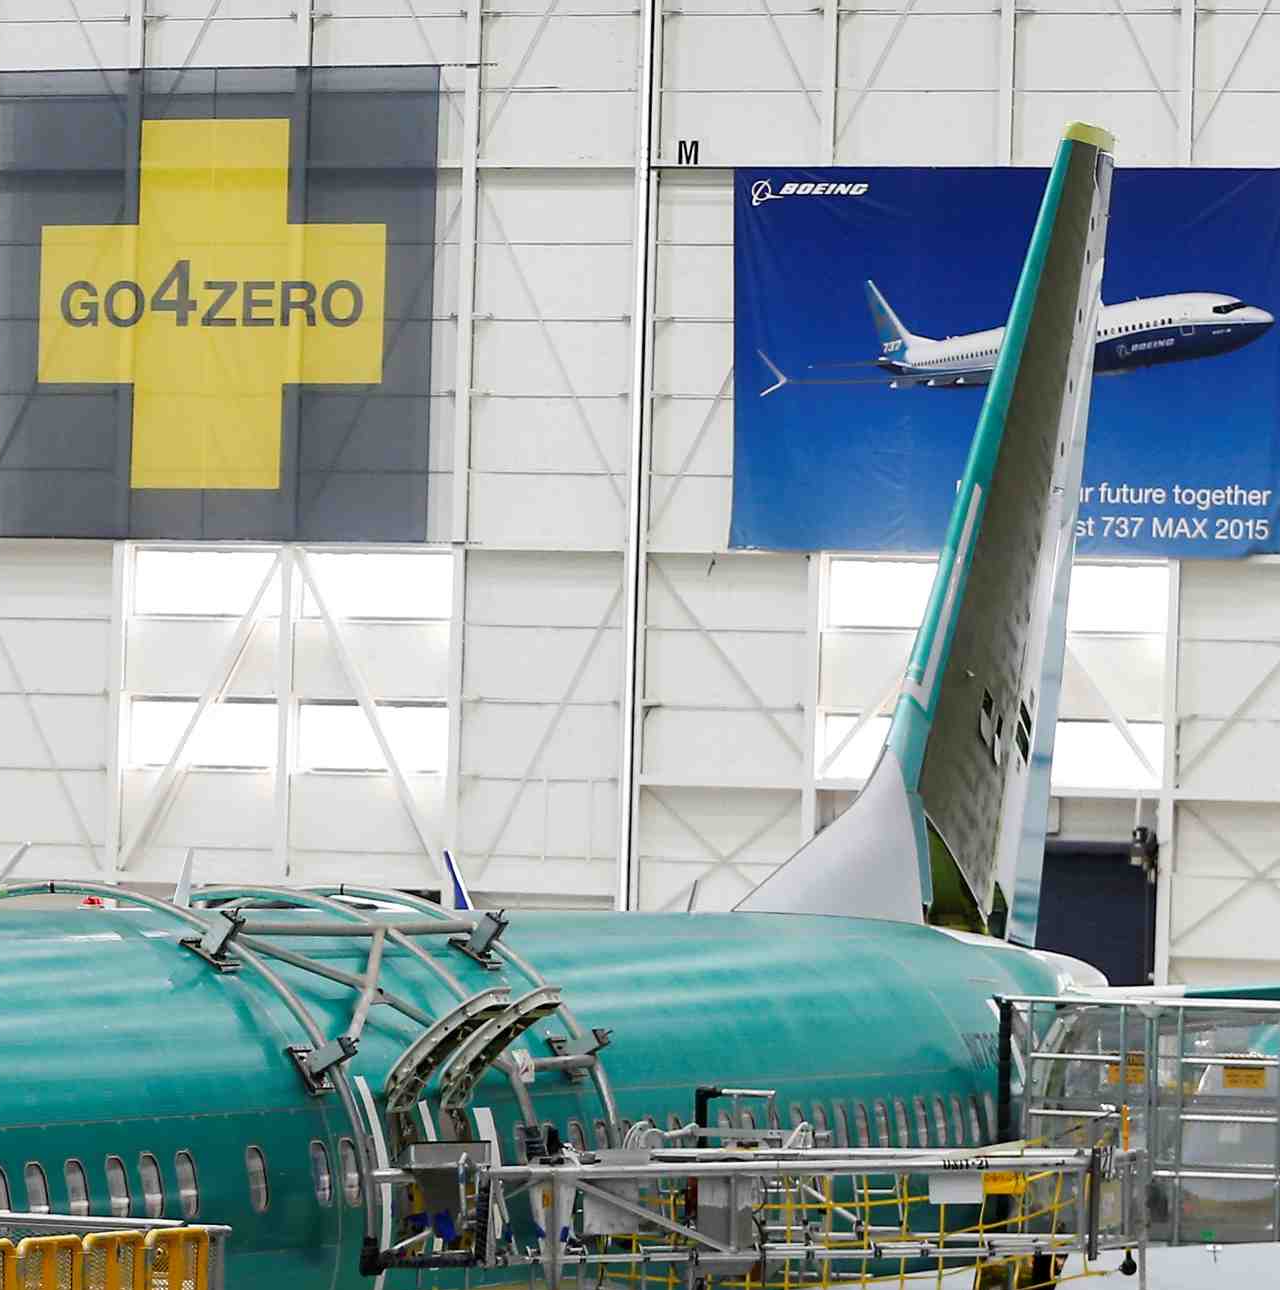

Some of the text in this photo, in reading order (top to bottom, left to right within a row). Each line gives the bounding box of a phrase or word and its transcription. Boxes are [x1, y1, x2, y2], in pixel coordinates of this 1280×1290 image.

[677, 139, 699, 165] M
[778, 182, 869, 197] BOEING
[60, 259, 364, 328] GO4ZERO
[1098, 481, 1165, 505] future
[1173, 482, 1272, 510] together
[1074, 516, 1270, 541] st 737 MAX 2015
